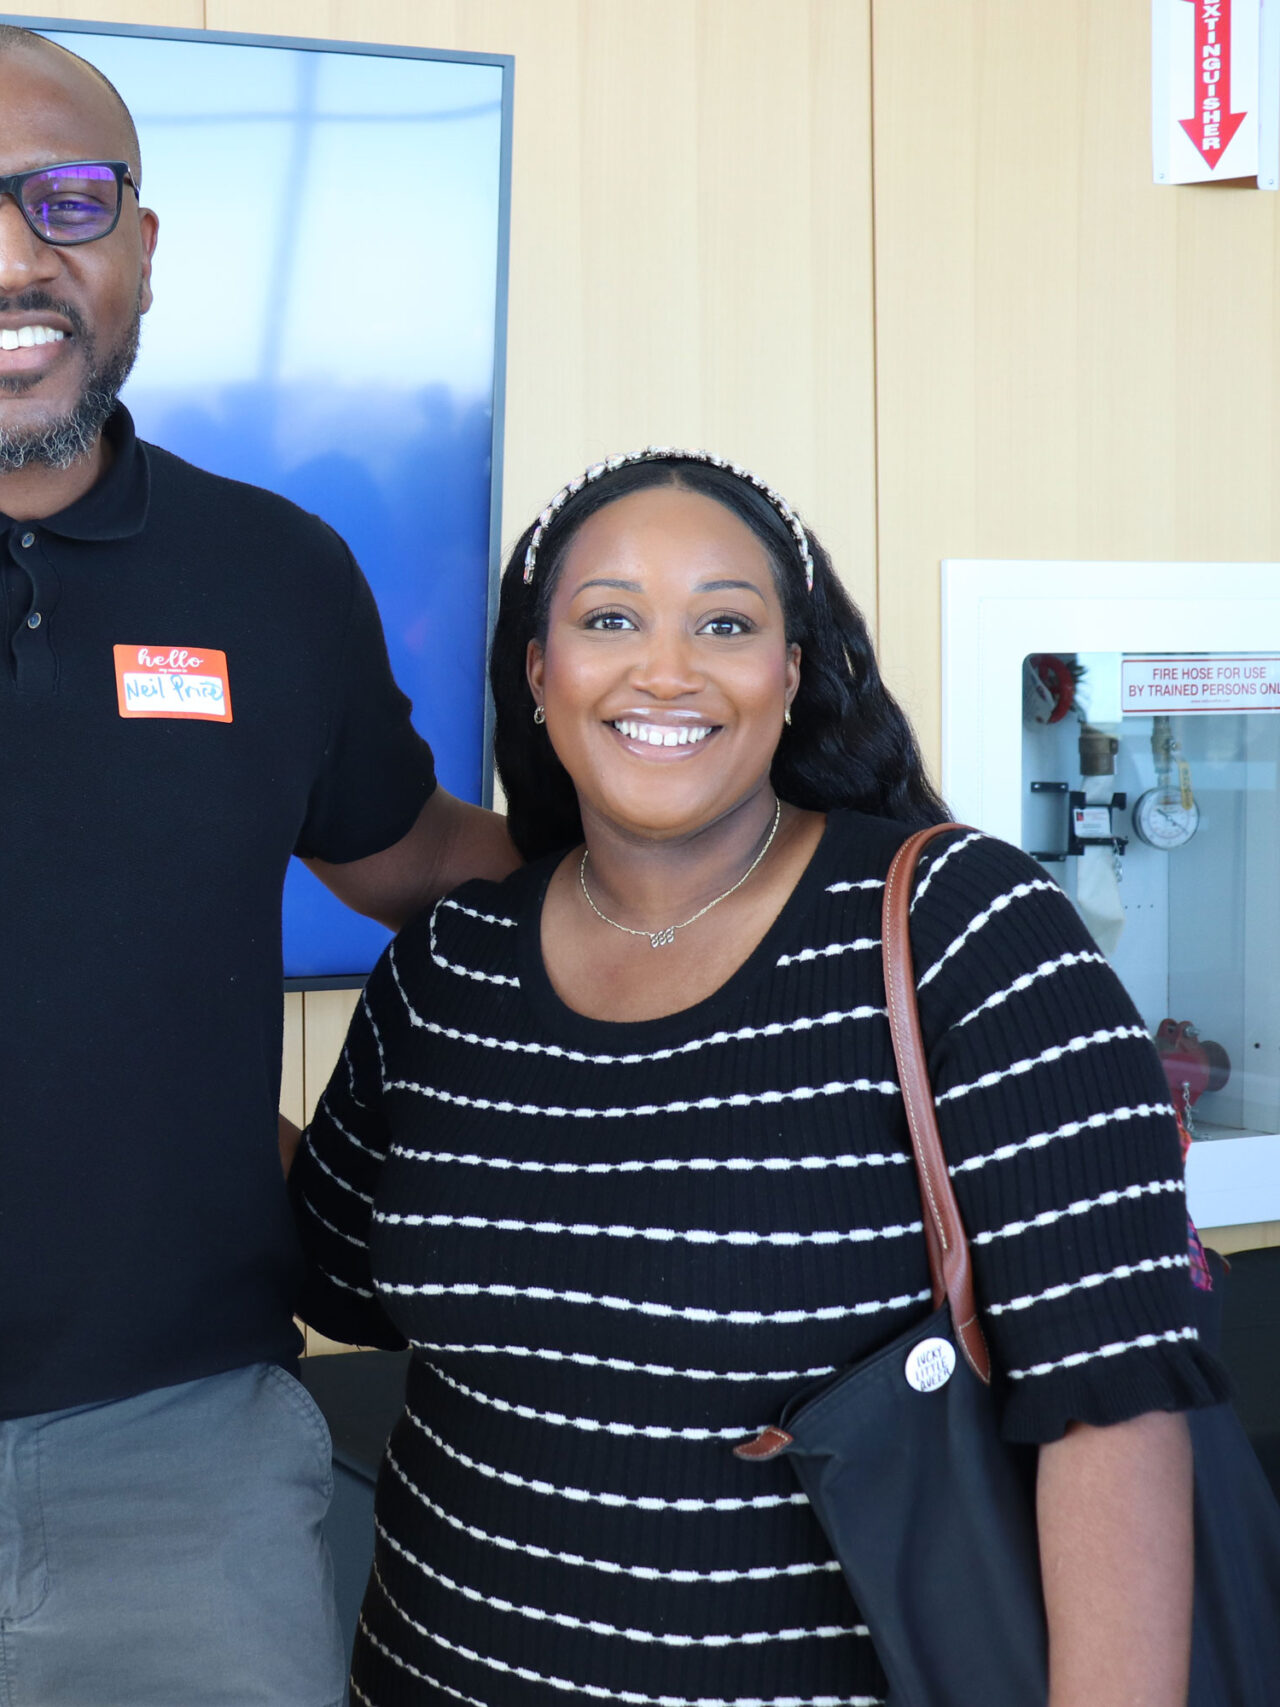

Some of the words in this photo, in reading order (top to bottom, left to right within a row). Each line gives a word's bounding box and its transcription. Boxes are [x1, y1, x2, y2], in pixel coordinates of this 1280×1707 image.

[138, 648, 204, 668] hello
[1153, 668, 1178, 680] FIRE
[1182, 668, 1213, 680] HOSE
[1217, 667, 1240, 679] FOR
[1244, 667, 1266, 679] USE
[126, 676, 165, 700] Neil
[170, 674, 224, 702] Price
[1129, 685, 1145, 697] BY
[1148, 684, 1199, 696] TRAINED
[1202, 683, 1257, 695] PERSONS
[915, 1355, 946, 1382] LITTLE
